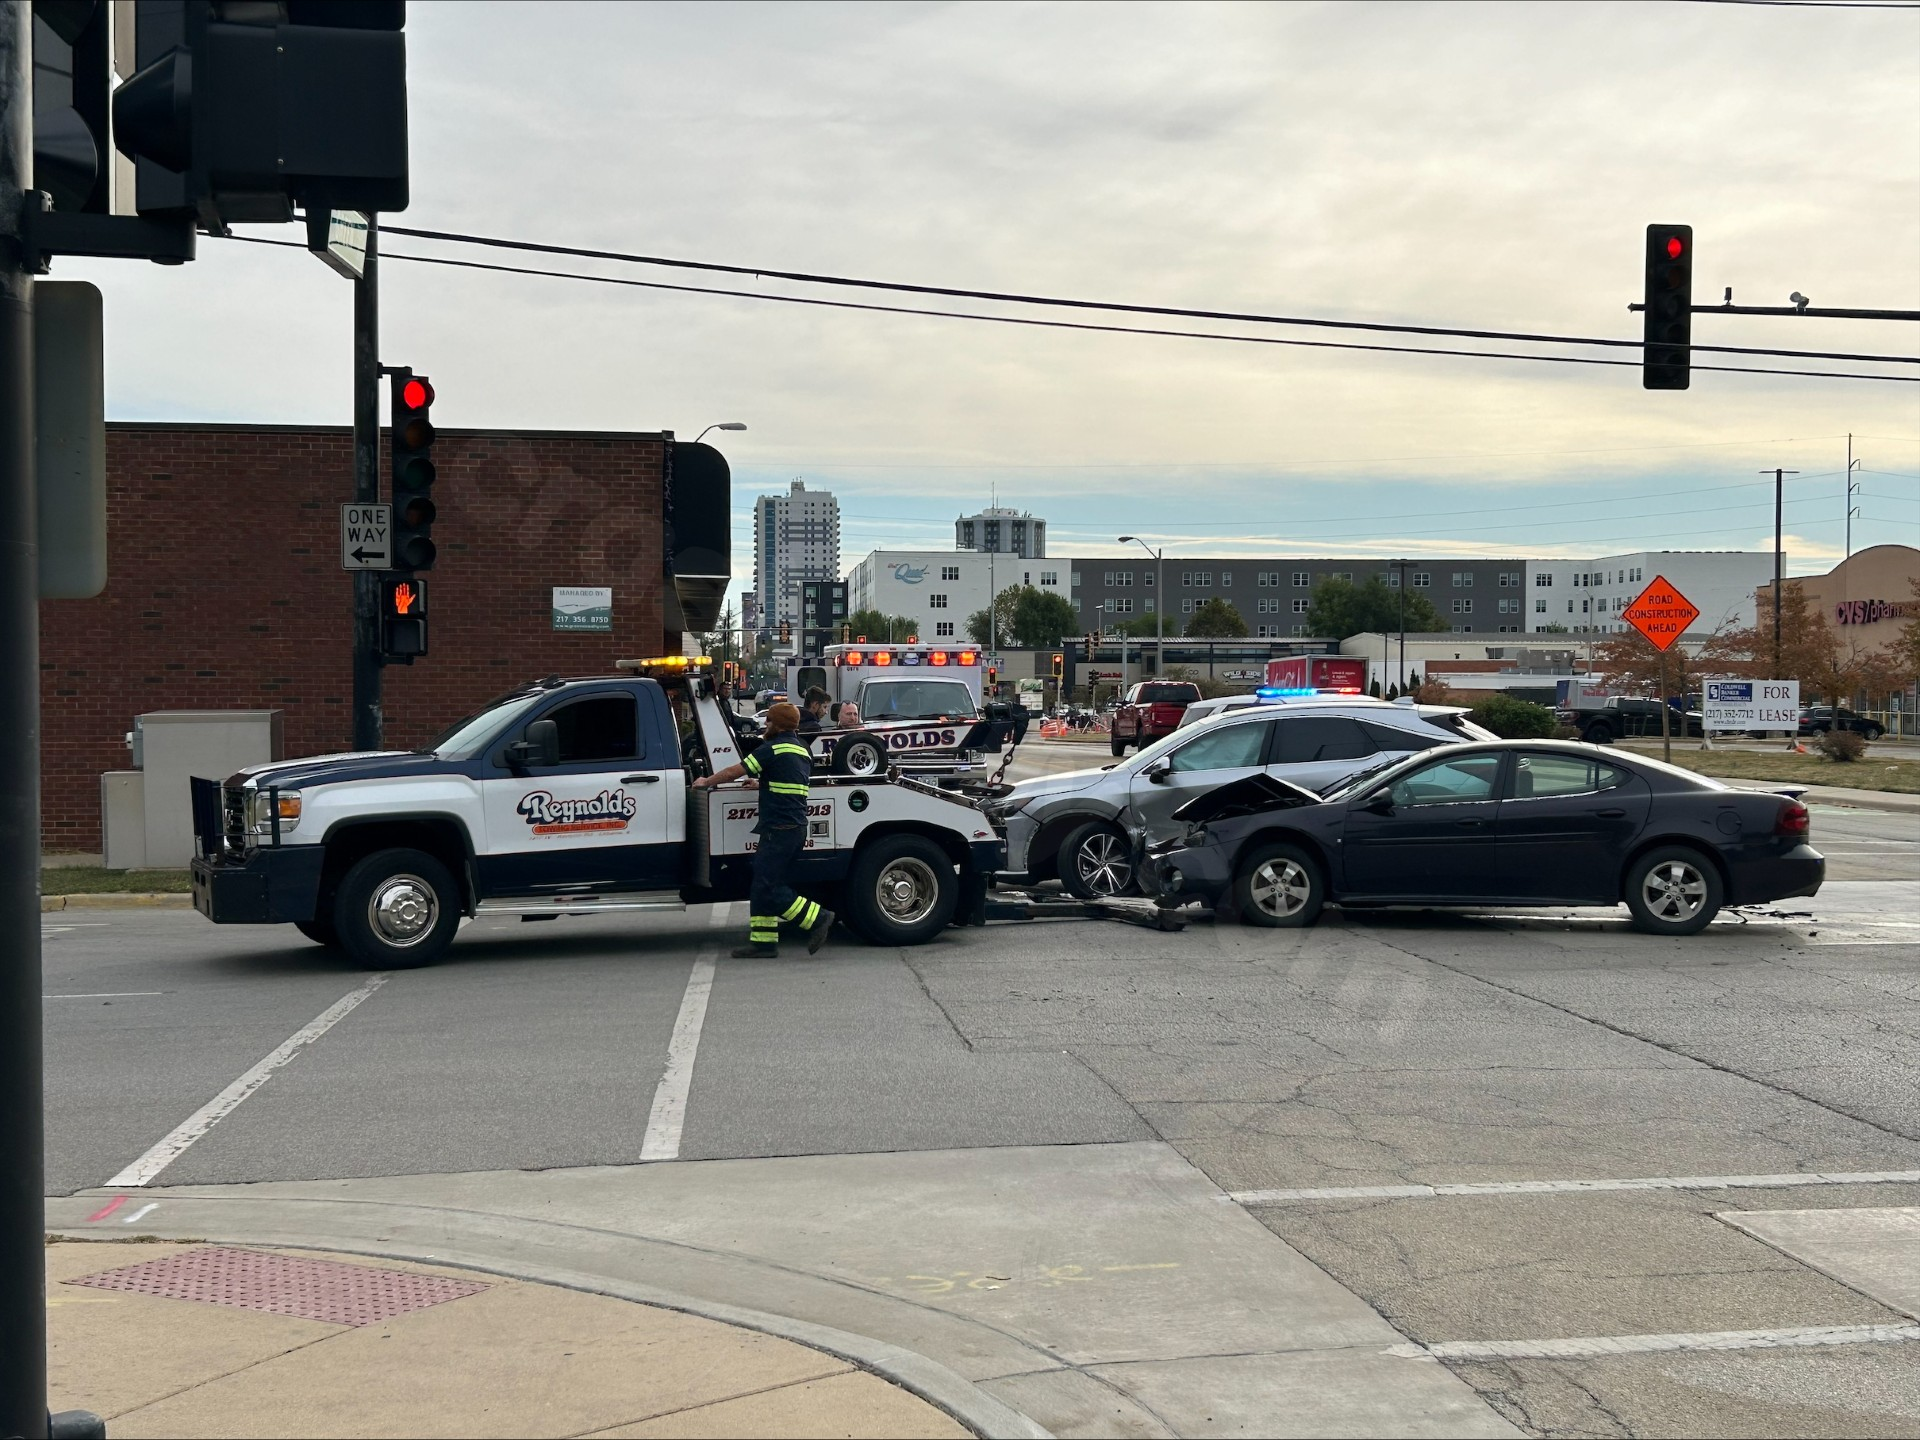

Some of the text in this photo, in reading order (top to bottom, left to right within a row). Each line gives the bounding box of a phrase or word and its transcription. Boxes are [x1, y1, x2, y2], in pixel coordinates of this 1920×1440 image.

[349, 509, 386, 524] ONE
[348, 527, 387, 542] WAY
[1648, 595, 1673, 605] ROAD
[556, 615, 569, 623] 217
[572, 615, 587, 623] 356
[1629, 608, 1692, 619] CONSTRUCTION
[1647, 623, 1677, 633] AHEAD
[1763, 686, 1790, 699] FOR
[1706, 709, 1722, 720] (217)
[1759, 709, 1797, 722] LEASE
[820, 729, 956, 754] RNOLDS
[517, 789, 636, 823] Reynolds
